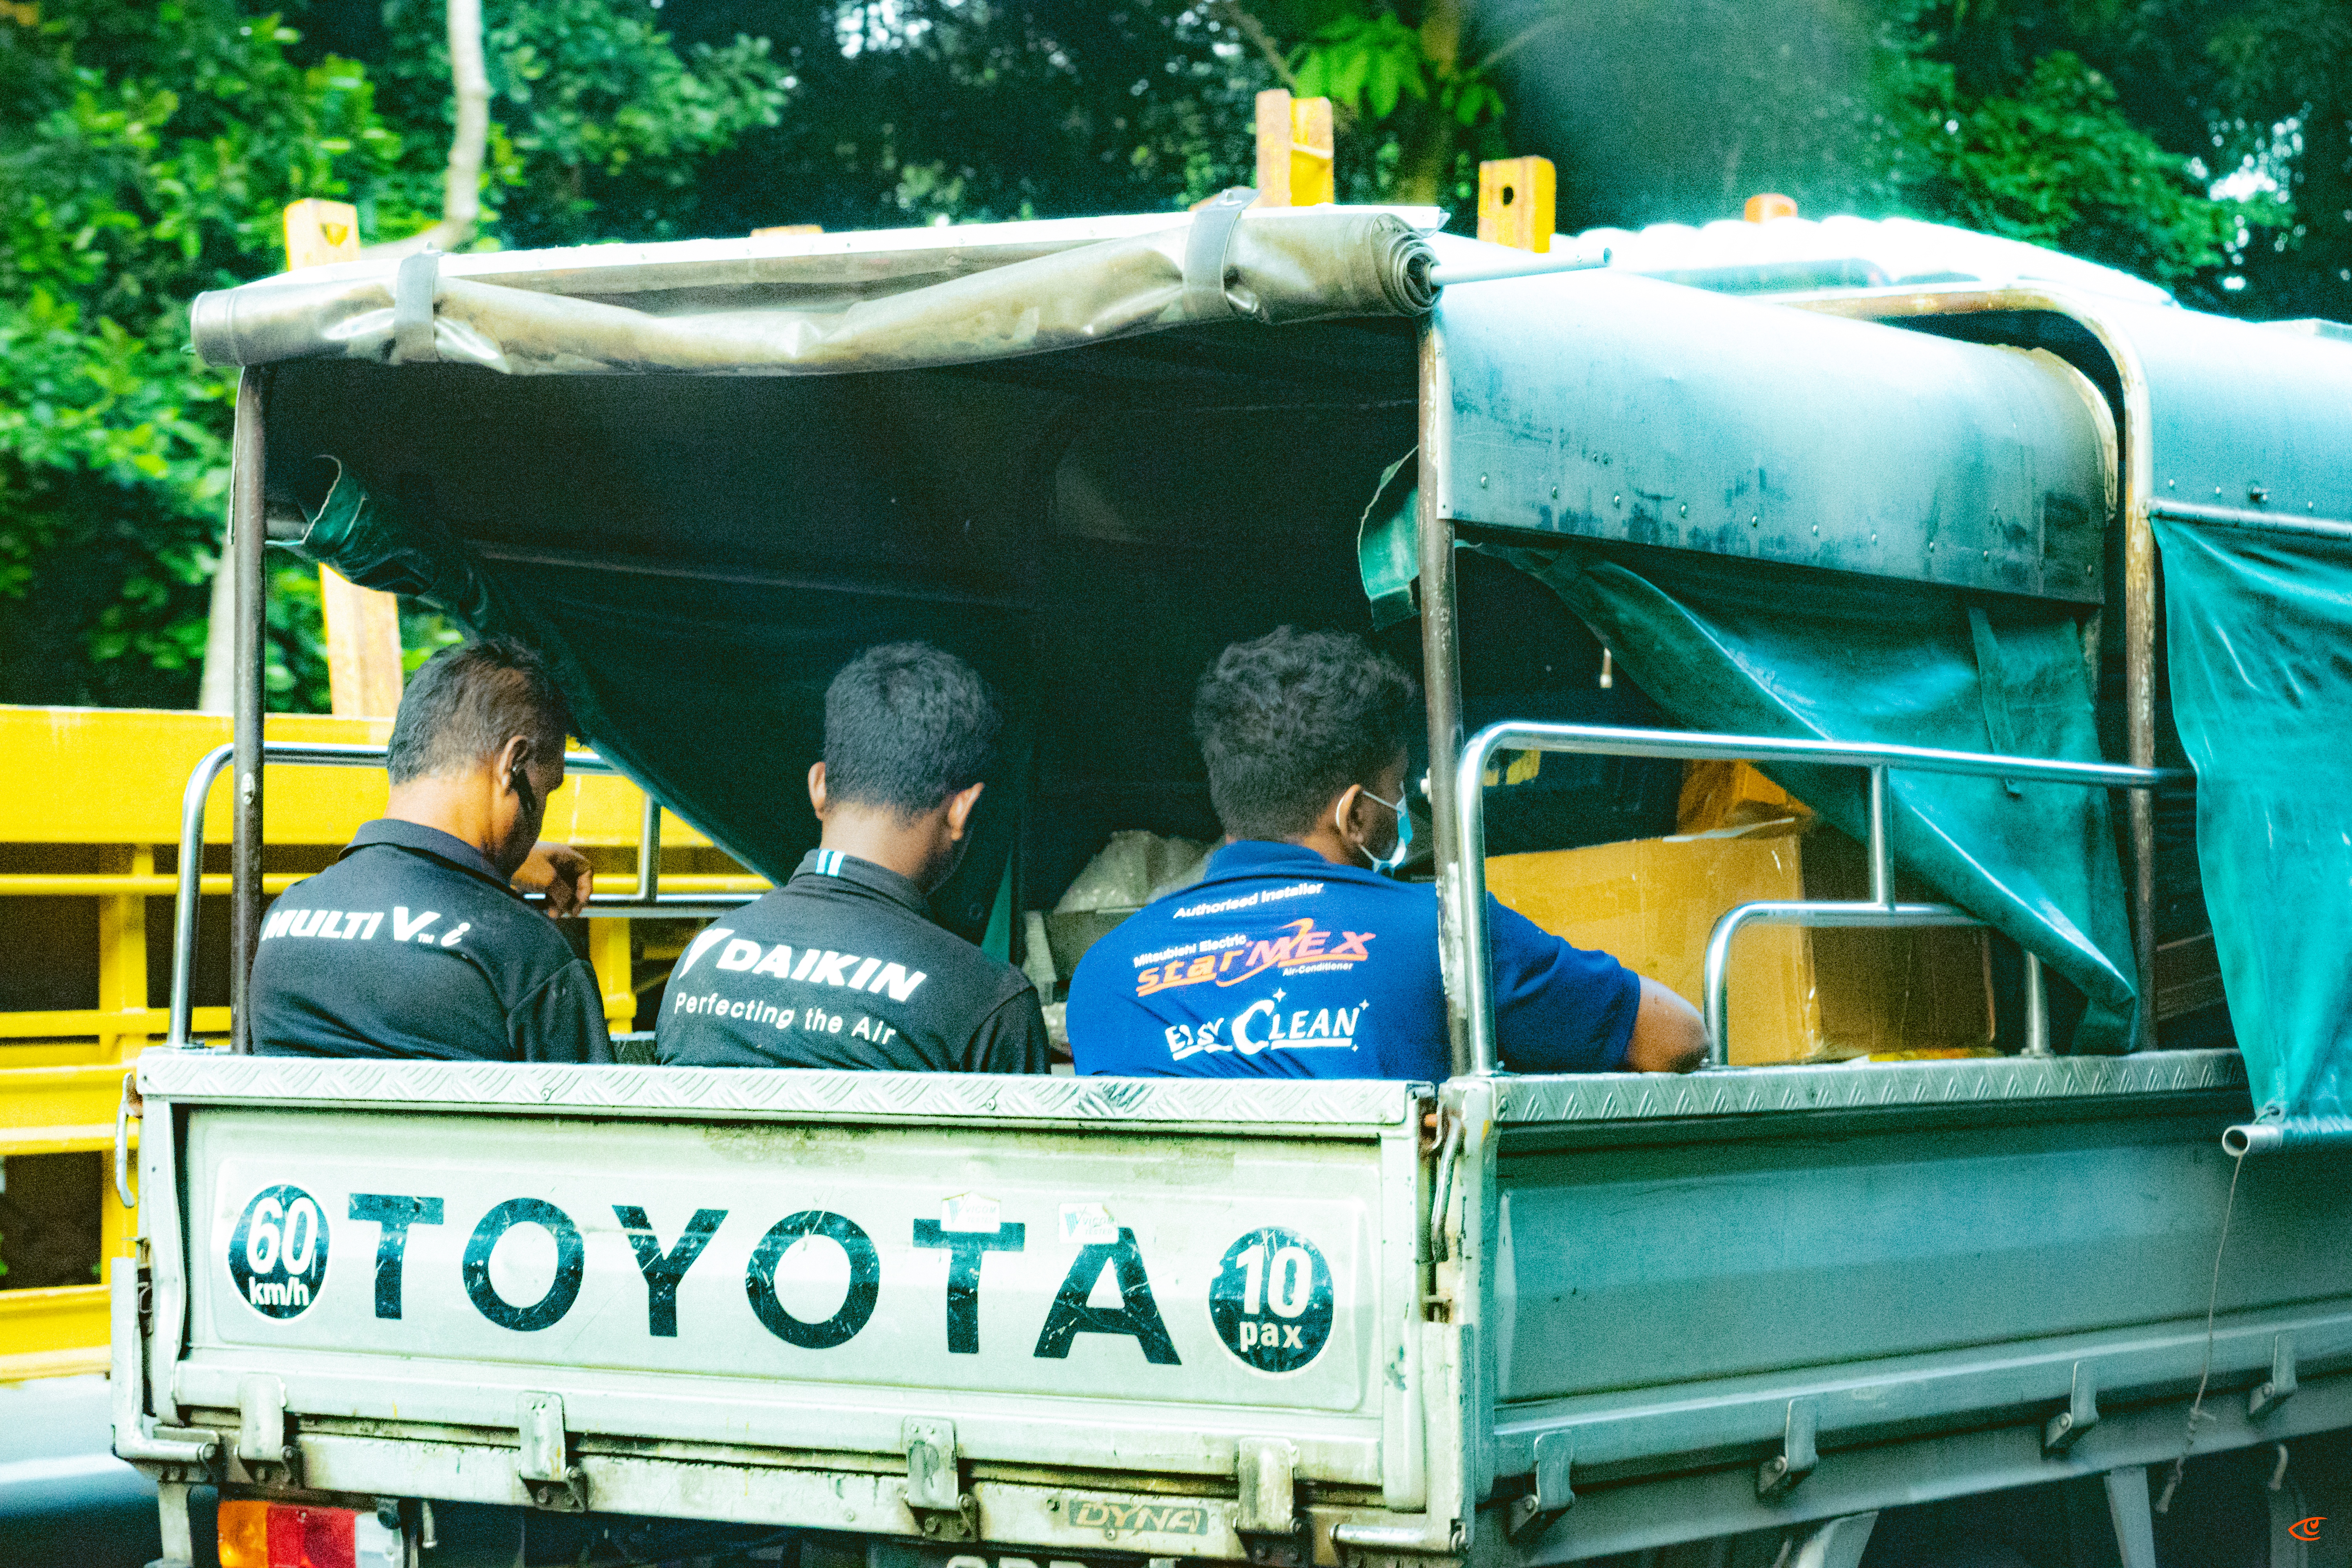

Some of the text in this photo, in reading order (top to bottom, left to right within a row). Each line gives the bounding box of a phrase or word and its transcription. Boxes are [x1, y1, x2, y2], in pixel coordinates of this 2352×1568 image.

[1173, 883, 1324, 919] Authorised Installer
[261, 909, 385, 941] MULTI
[1134, 934, 1247, 968] Mitsubishi Electric
[716, 938, 927, 1002] DAIKIN
[1282, 962, 1353, 976] Air-Conditioner
[674, 992, 896, 1044] Perfecting the Air
[965, 1206, 997, 1214] VICOM
[967, 1216, 994, 1224] TESTED
[246, 1197, 318, 1275] 60
[249, 1276, 309, 1307] km/h
[348, 1192, 1182, 1366] TOYOTA
[1236, 1245, 1312, 1318] 10
[1239, 1321, 1304, 1352] pax
[1076, 1503, 1202, 1534] DYNA
